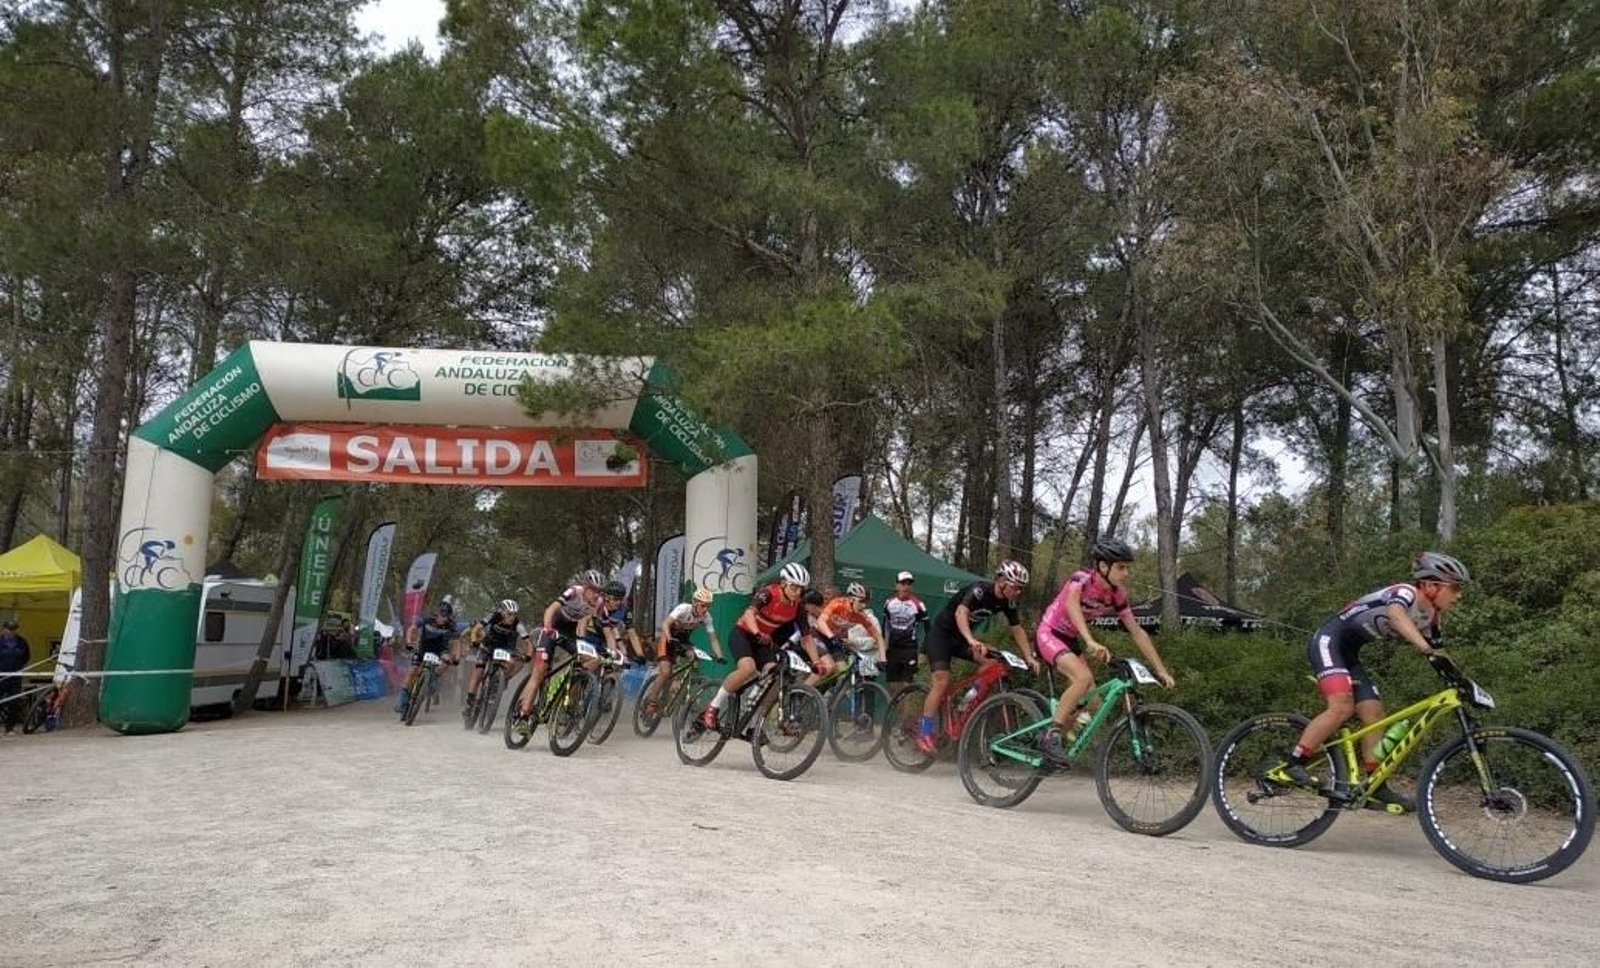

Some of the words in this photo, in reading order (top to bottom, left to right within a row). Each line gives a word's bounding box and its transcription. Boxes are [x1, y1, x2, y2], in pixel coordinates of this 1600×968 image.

[435, 367, 530, 380] ANDALUZA
[464, 383, 487, 396] DE
[168, 393, 228, 444] ANDALUZA
[192, 421, 211, 439] DE
[209, 382, 260, 426] CICLISMO
[346, 434, 561, 476] SALIDA
[310, 512, 332, 605] ÚNETE
